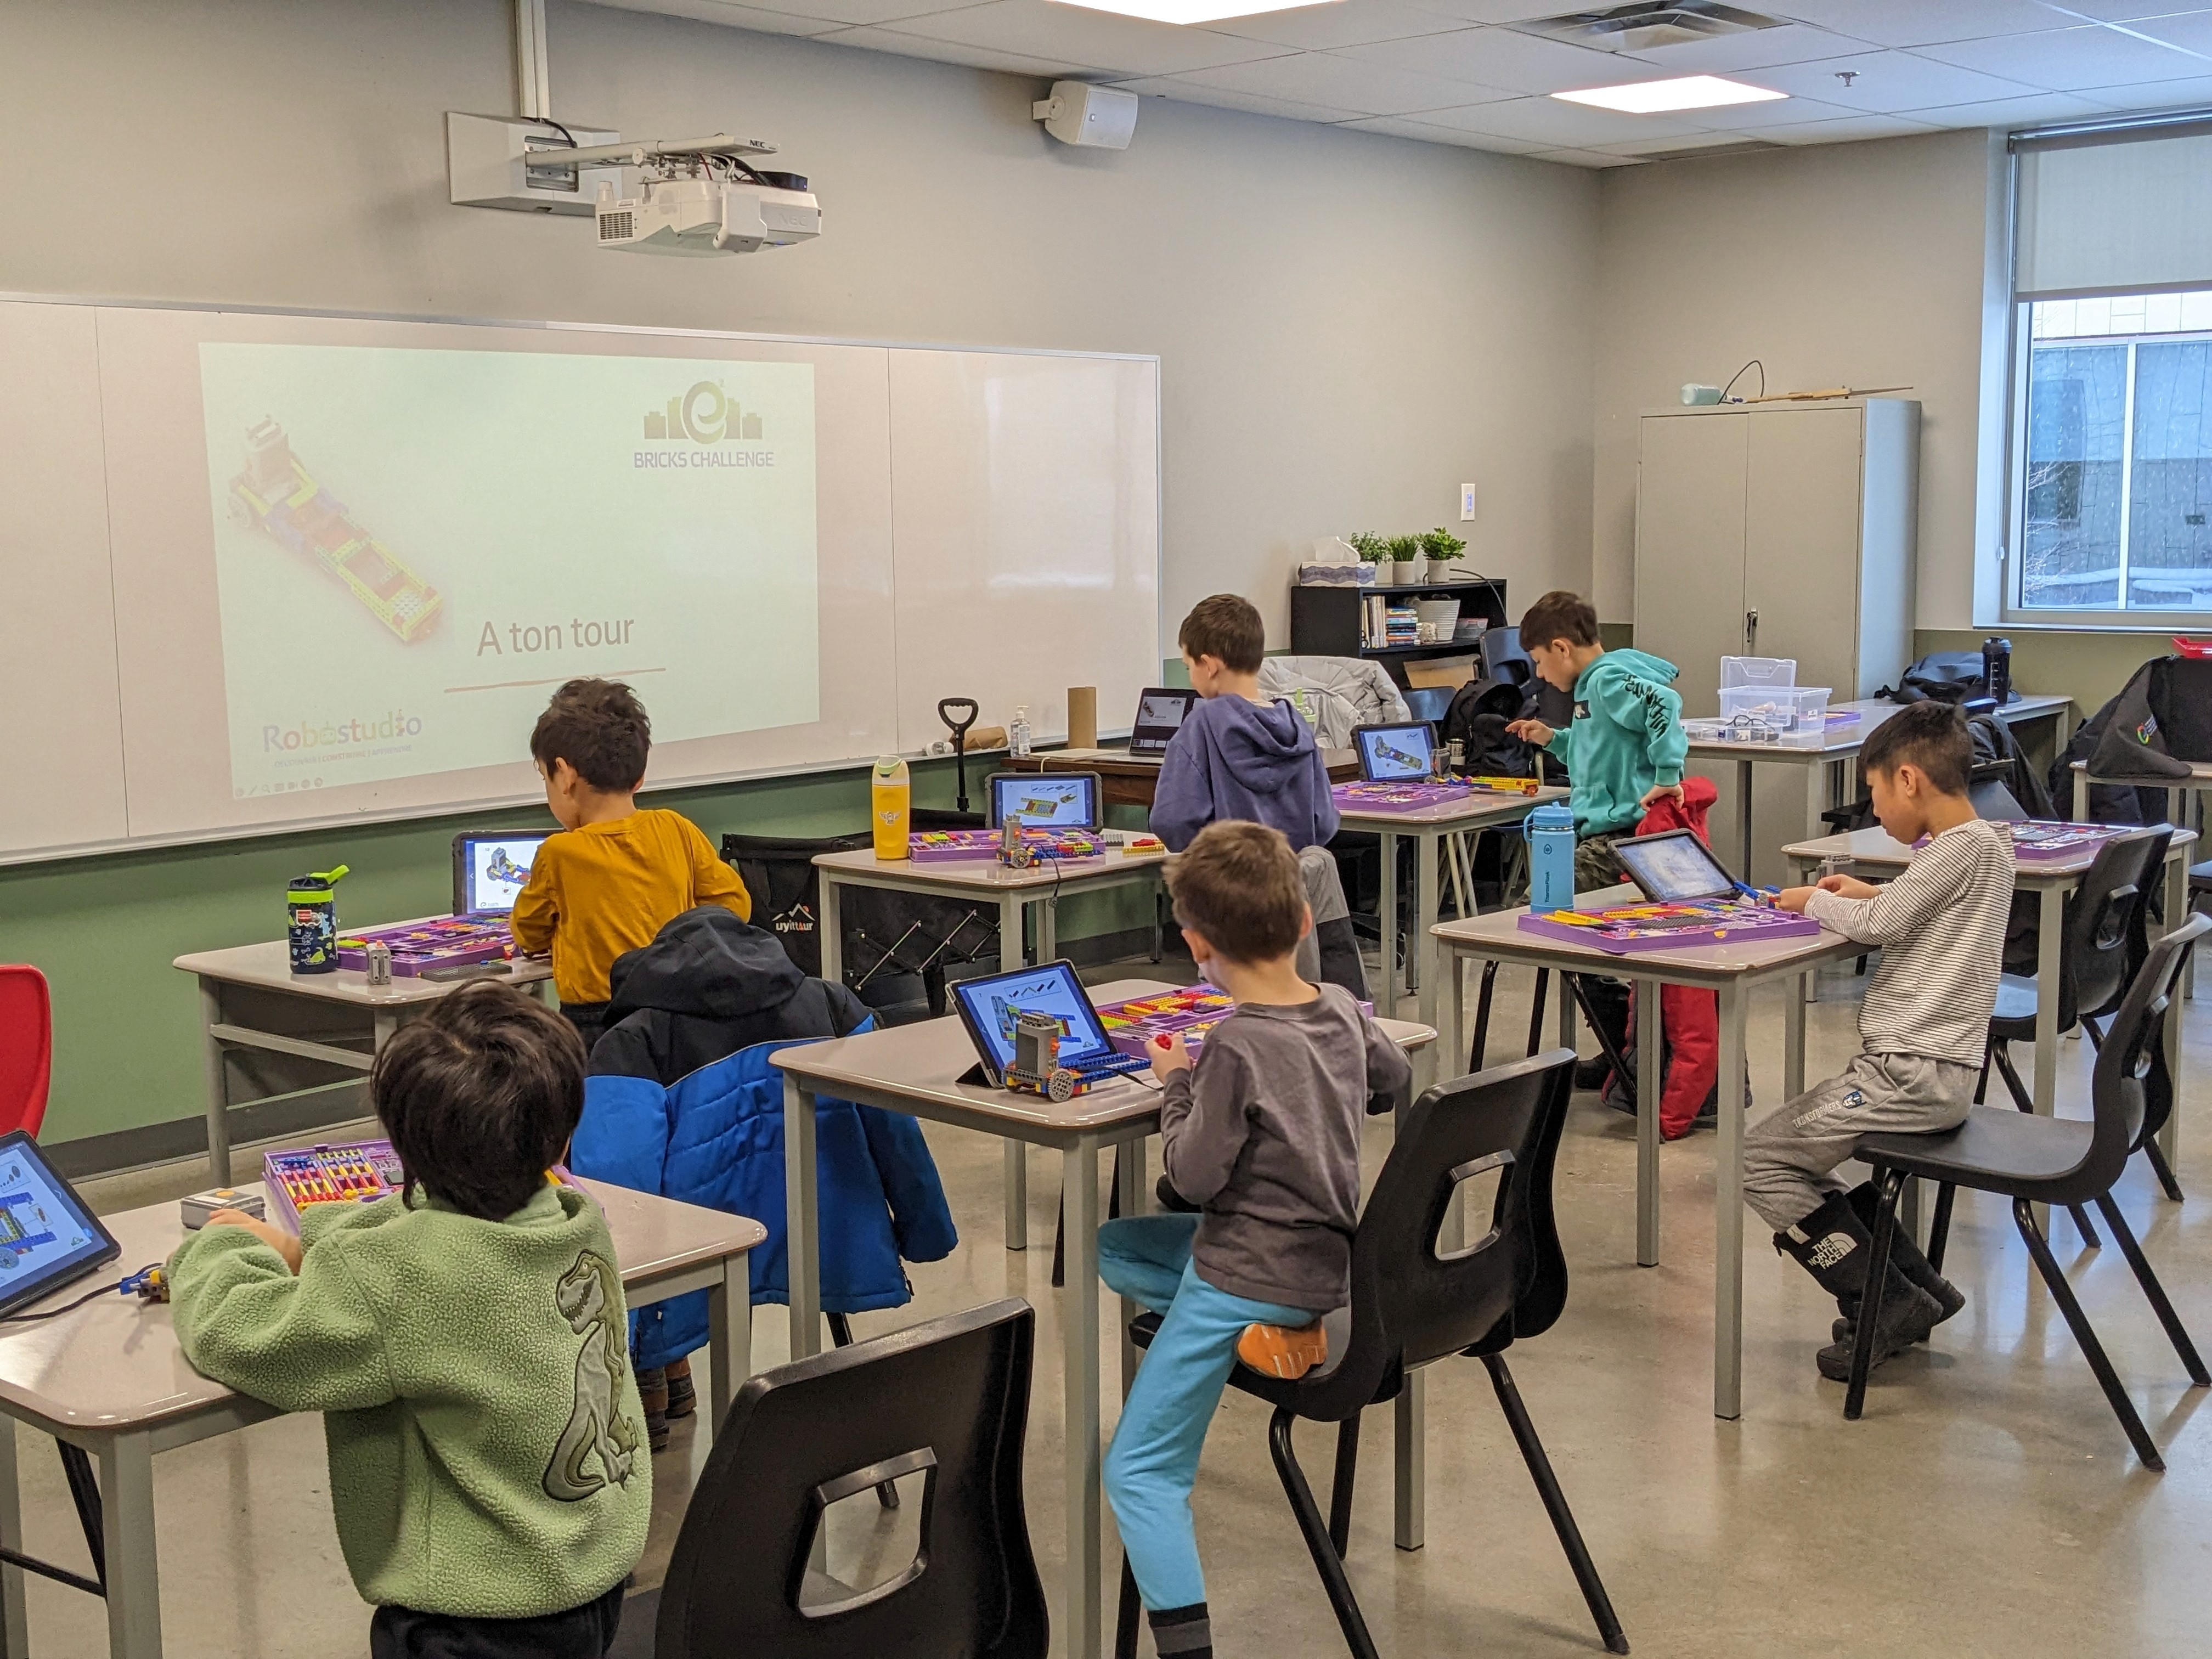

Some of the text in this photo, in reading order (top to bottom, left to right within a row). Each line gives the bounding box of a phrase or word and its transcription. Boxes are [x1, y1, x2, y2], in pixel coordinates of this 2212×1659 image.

[749, 140, 765, 148] NEC
[634, 452, 774, 468] BRICKS CHALLENGE
[477, 618, 634, 657] A ton tour
[1792, 1101, 1842, 1129] TRANSFORMERS
[1807, 1243, 1838, 1266] NORTH
[1812, 1237, 1832, 1253] THE
[1820, 1250, 1844, 1270] FACE
